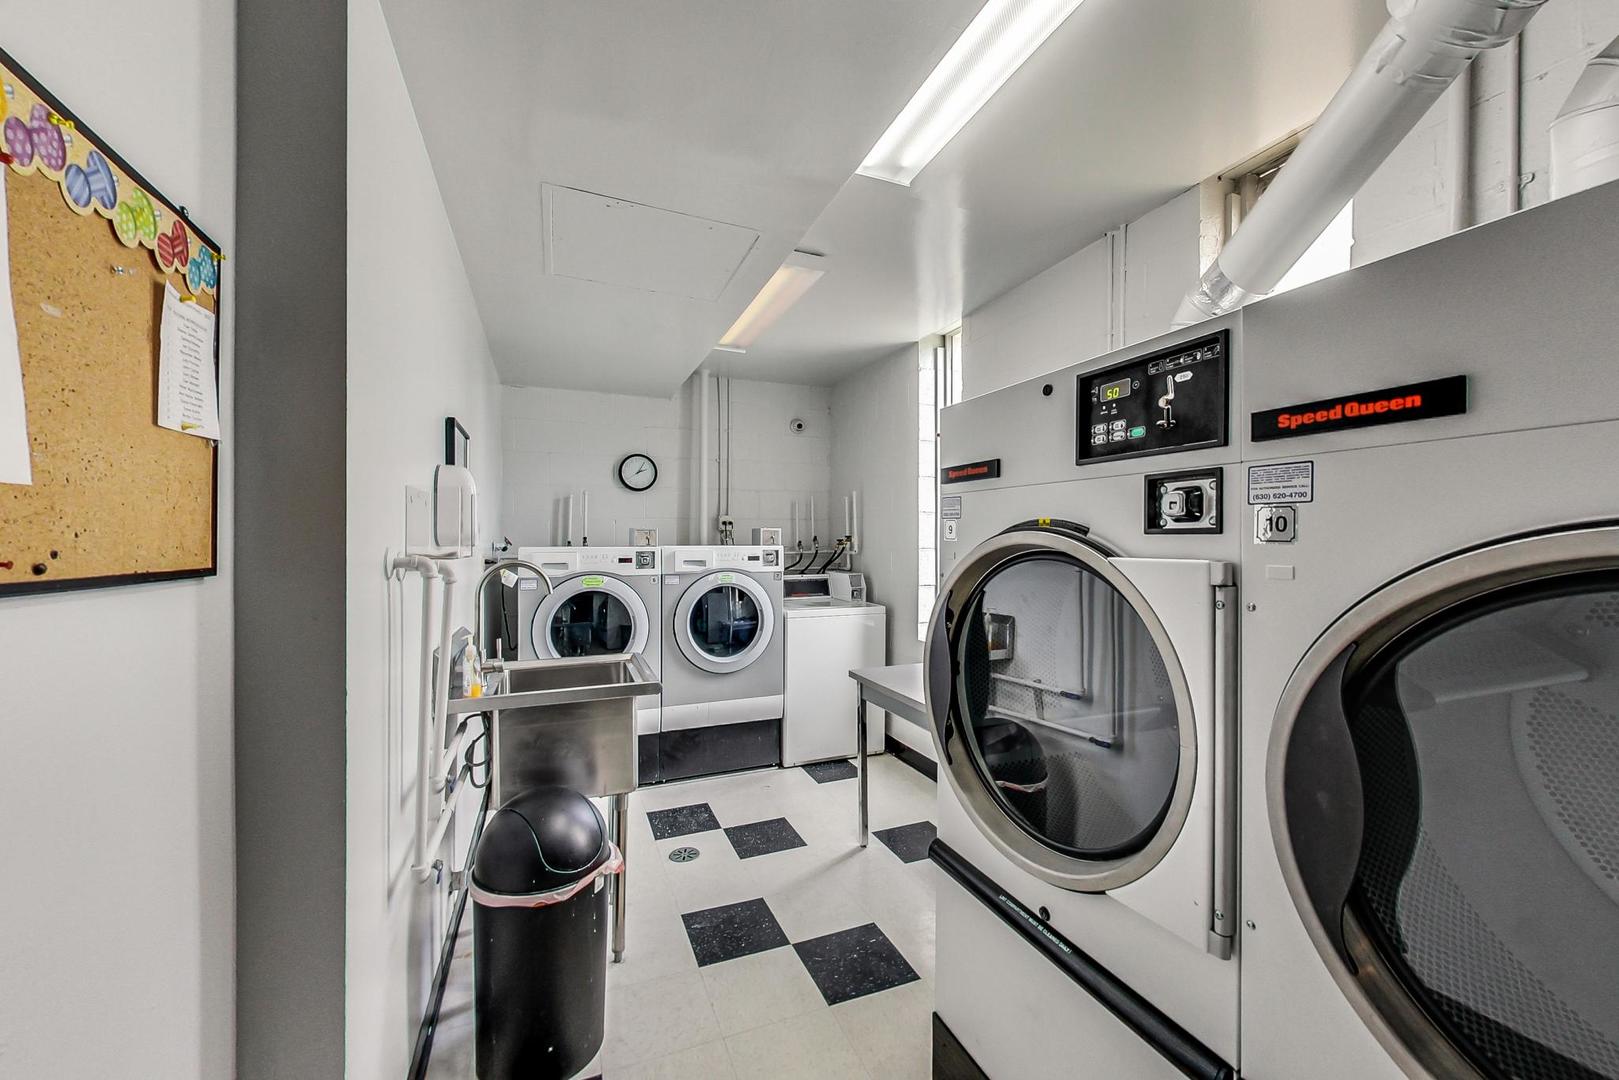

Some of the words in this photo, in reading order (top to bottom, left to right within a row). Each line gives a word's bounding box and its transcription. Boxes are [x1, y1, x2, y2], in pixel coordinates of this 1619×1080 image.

[1106, 387, 1120, 400] 50
[1277, 404, 1342, 429] Speed
[1344, 394, 1422, 417] Queen
[1252, 493, 1271, 501] (630)
[1272, 491, 1308, 500] 620-4700
[948, 525, 953, 535] 9
[1265, 515, 1288, 533] 10
